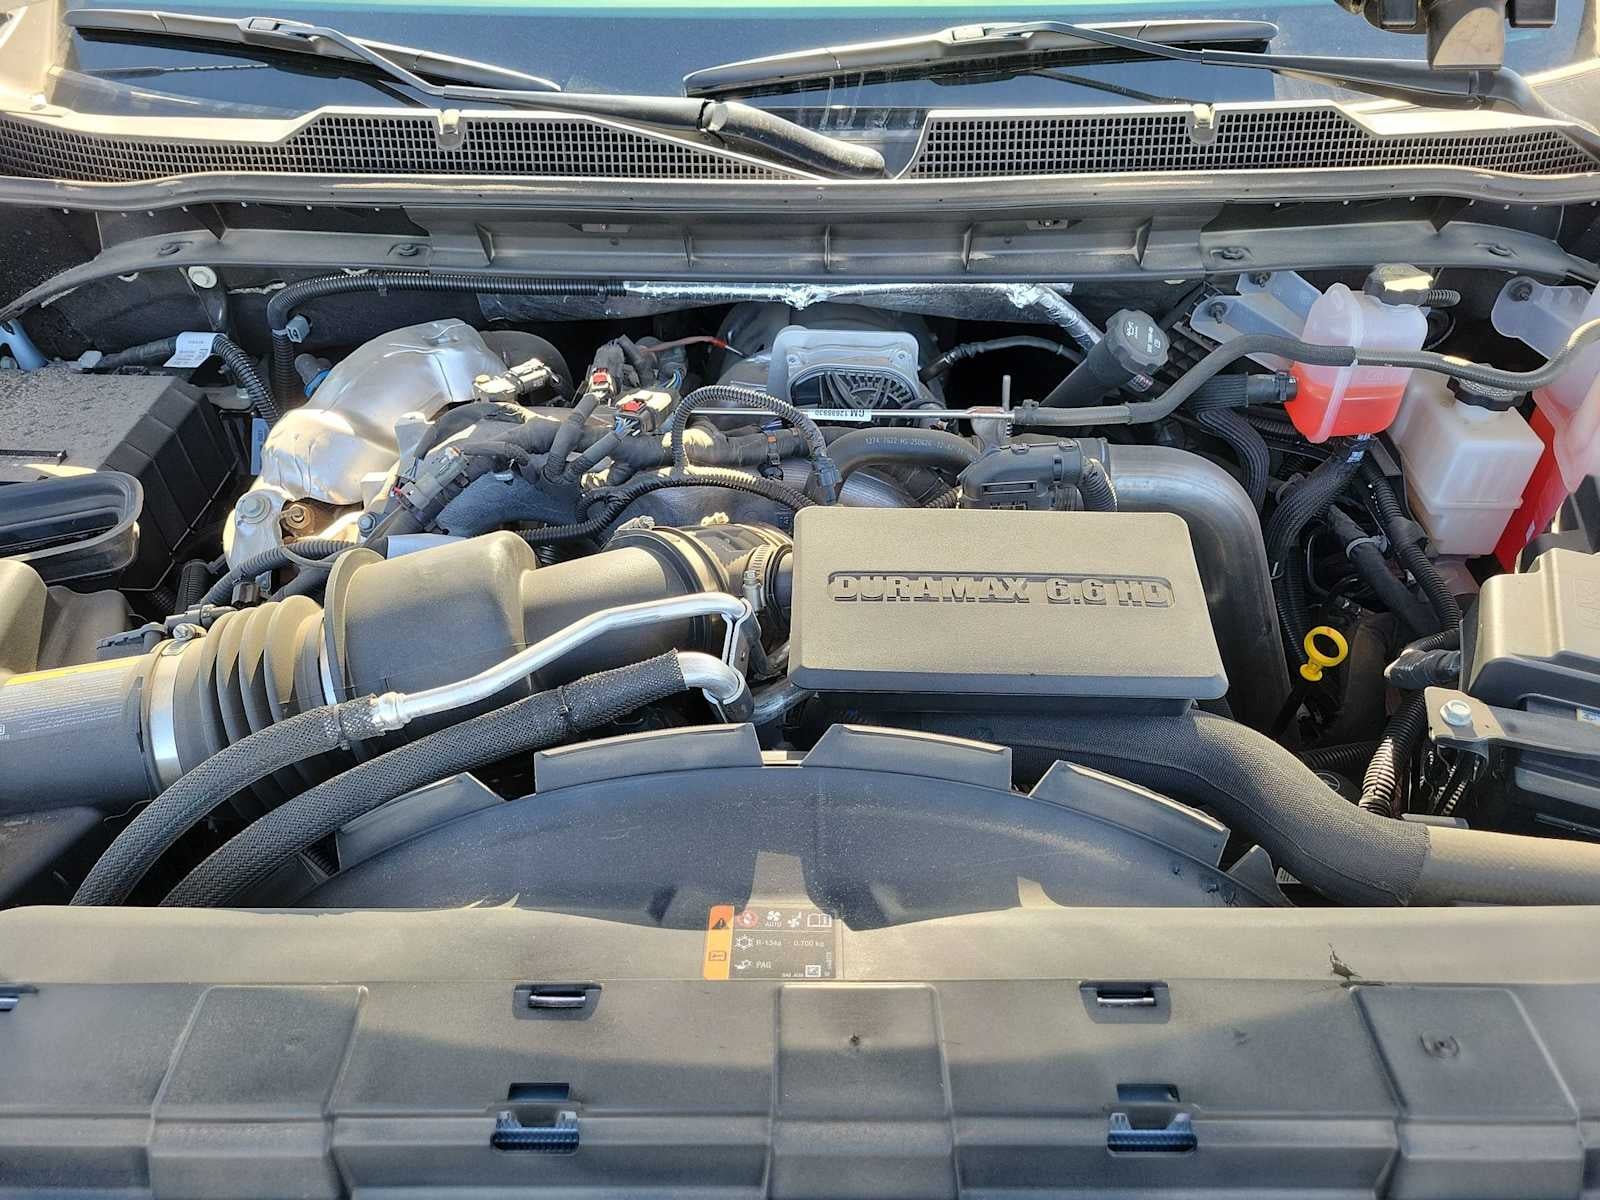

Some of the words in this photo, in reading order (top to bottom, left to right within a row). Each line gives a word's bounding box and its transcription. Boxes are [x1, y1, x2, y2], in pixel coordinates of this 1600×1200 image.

[851, 409, 865, 417] GM
[834, 576, 1030, 603] DURAMAX
[1047, 578, 1108, 605] 6.6
[1116, 580, 1171, 607] HD
[756, 961, 772, 969] PAG
